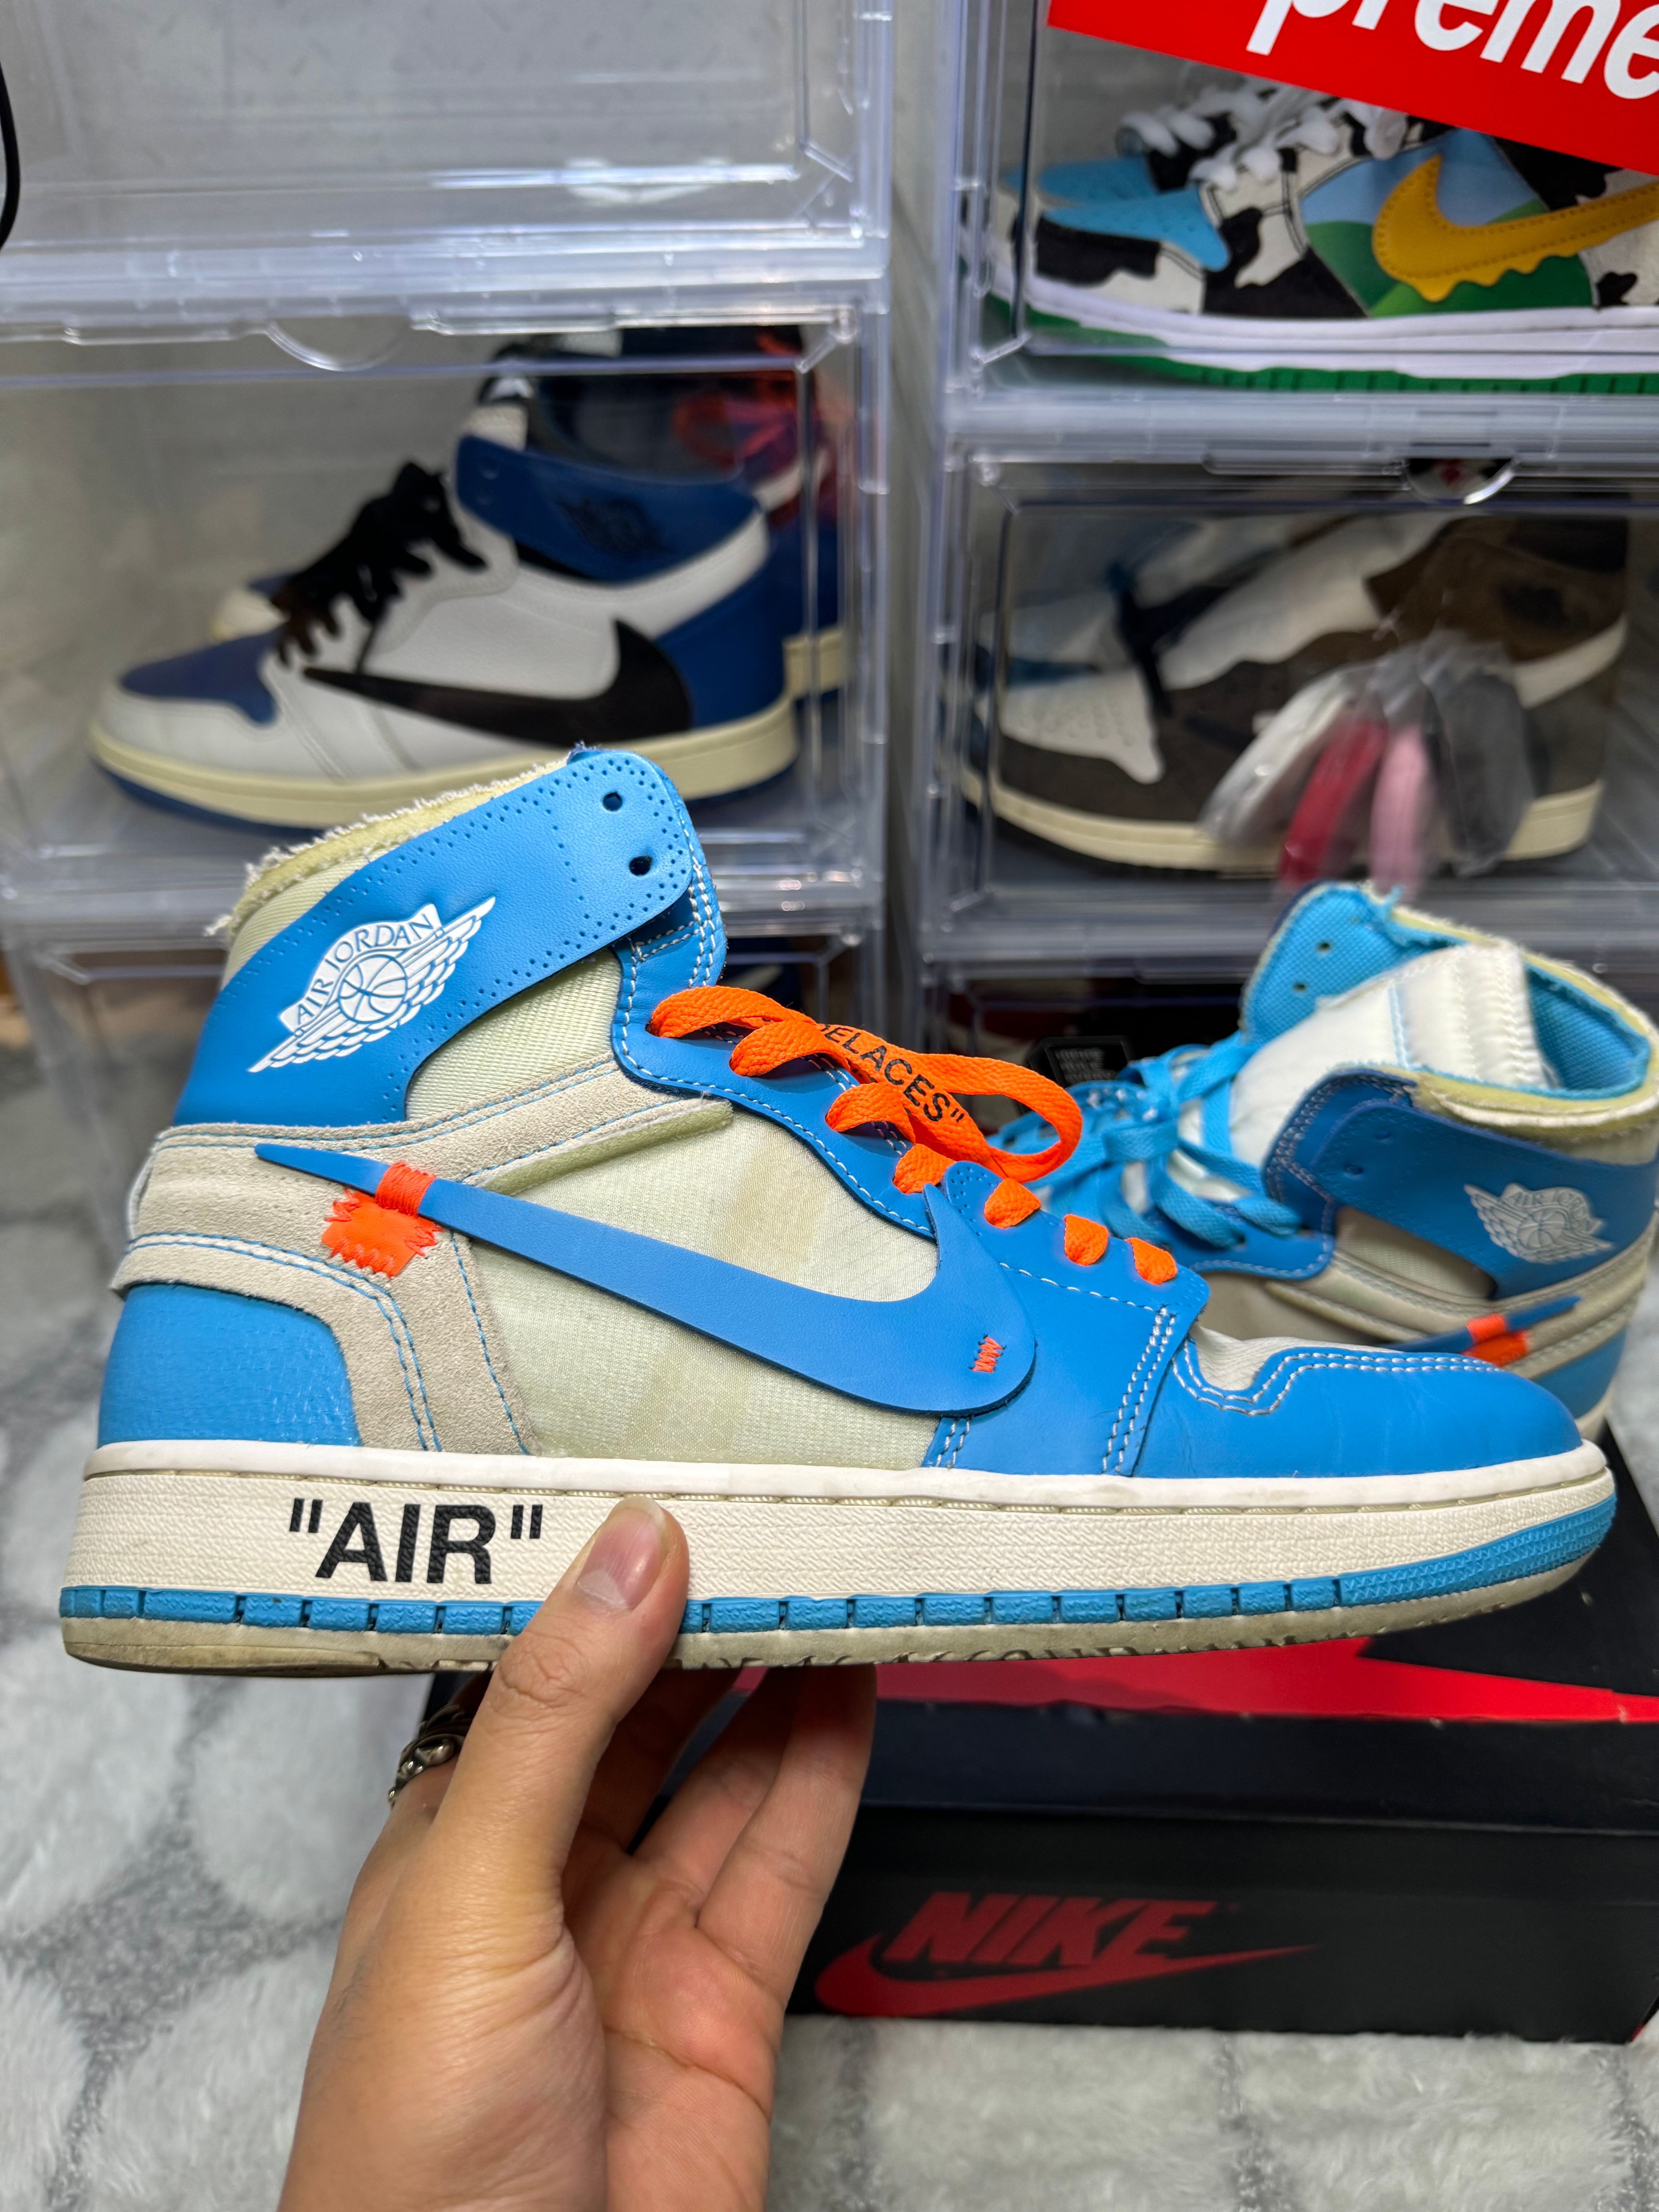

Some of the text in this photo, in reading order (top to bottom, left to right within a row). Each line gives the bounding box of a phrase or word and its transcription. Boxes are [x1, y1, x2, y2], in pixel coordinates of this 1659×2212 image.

[297, 913, 435, 1025] AIR JORDAN
[821, 1024, 965, 1122] ELACES"
[289, 1498, 543, 1584] "AIR"
[882, 1891, 1218, 1965] NIKE
